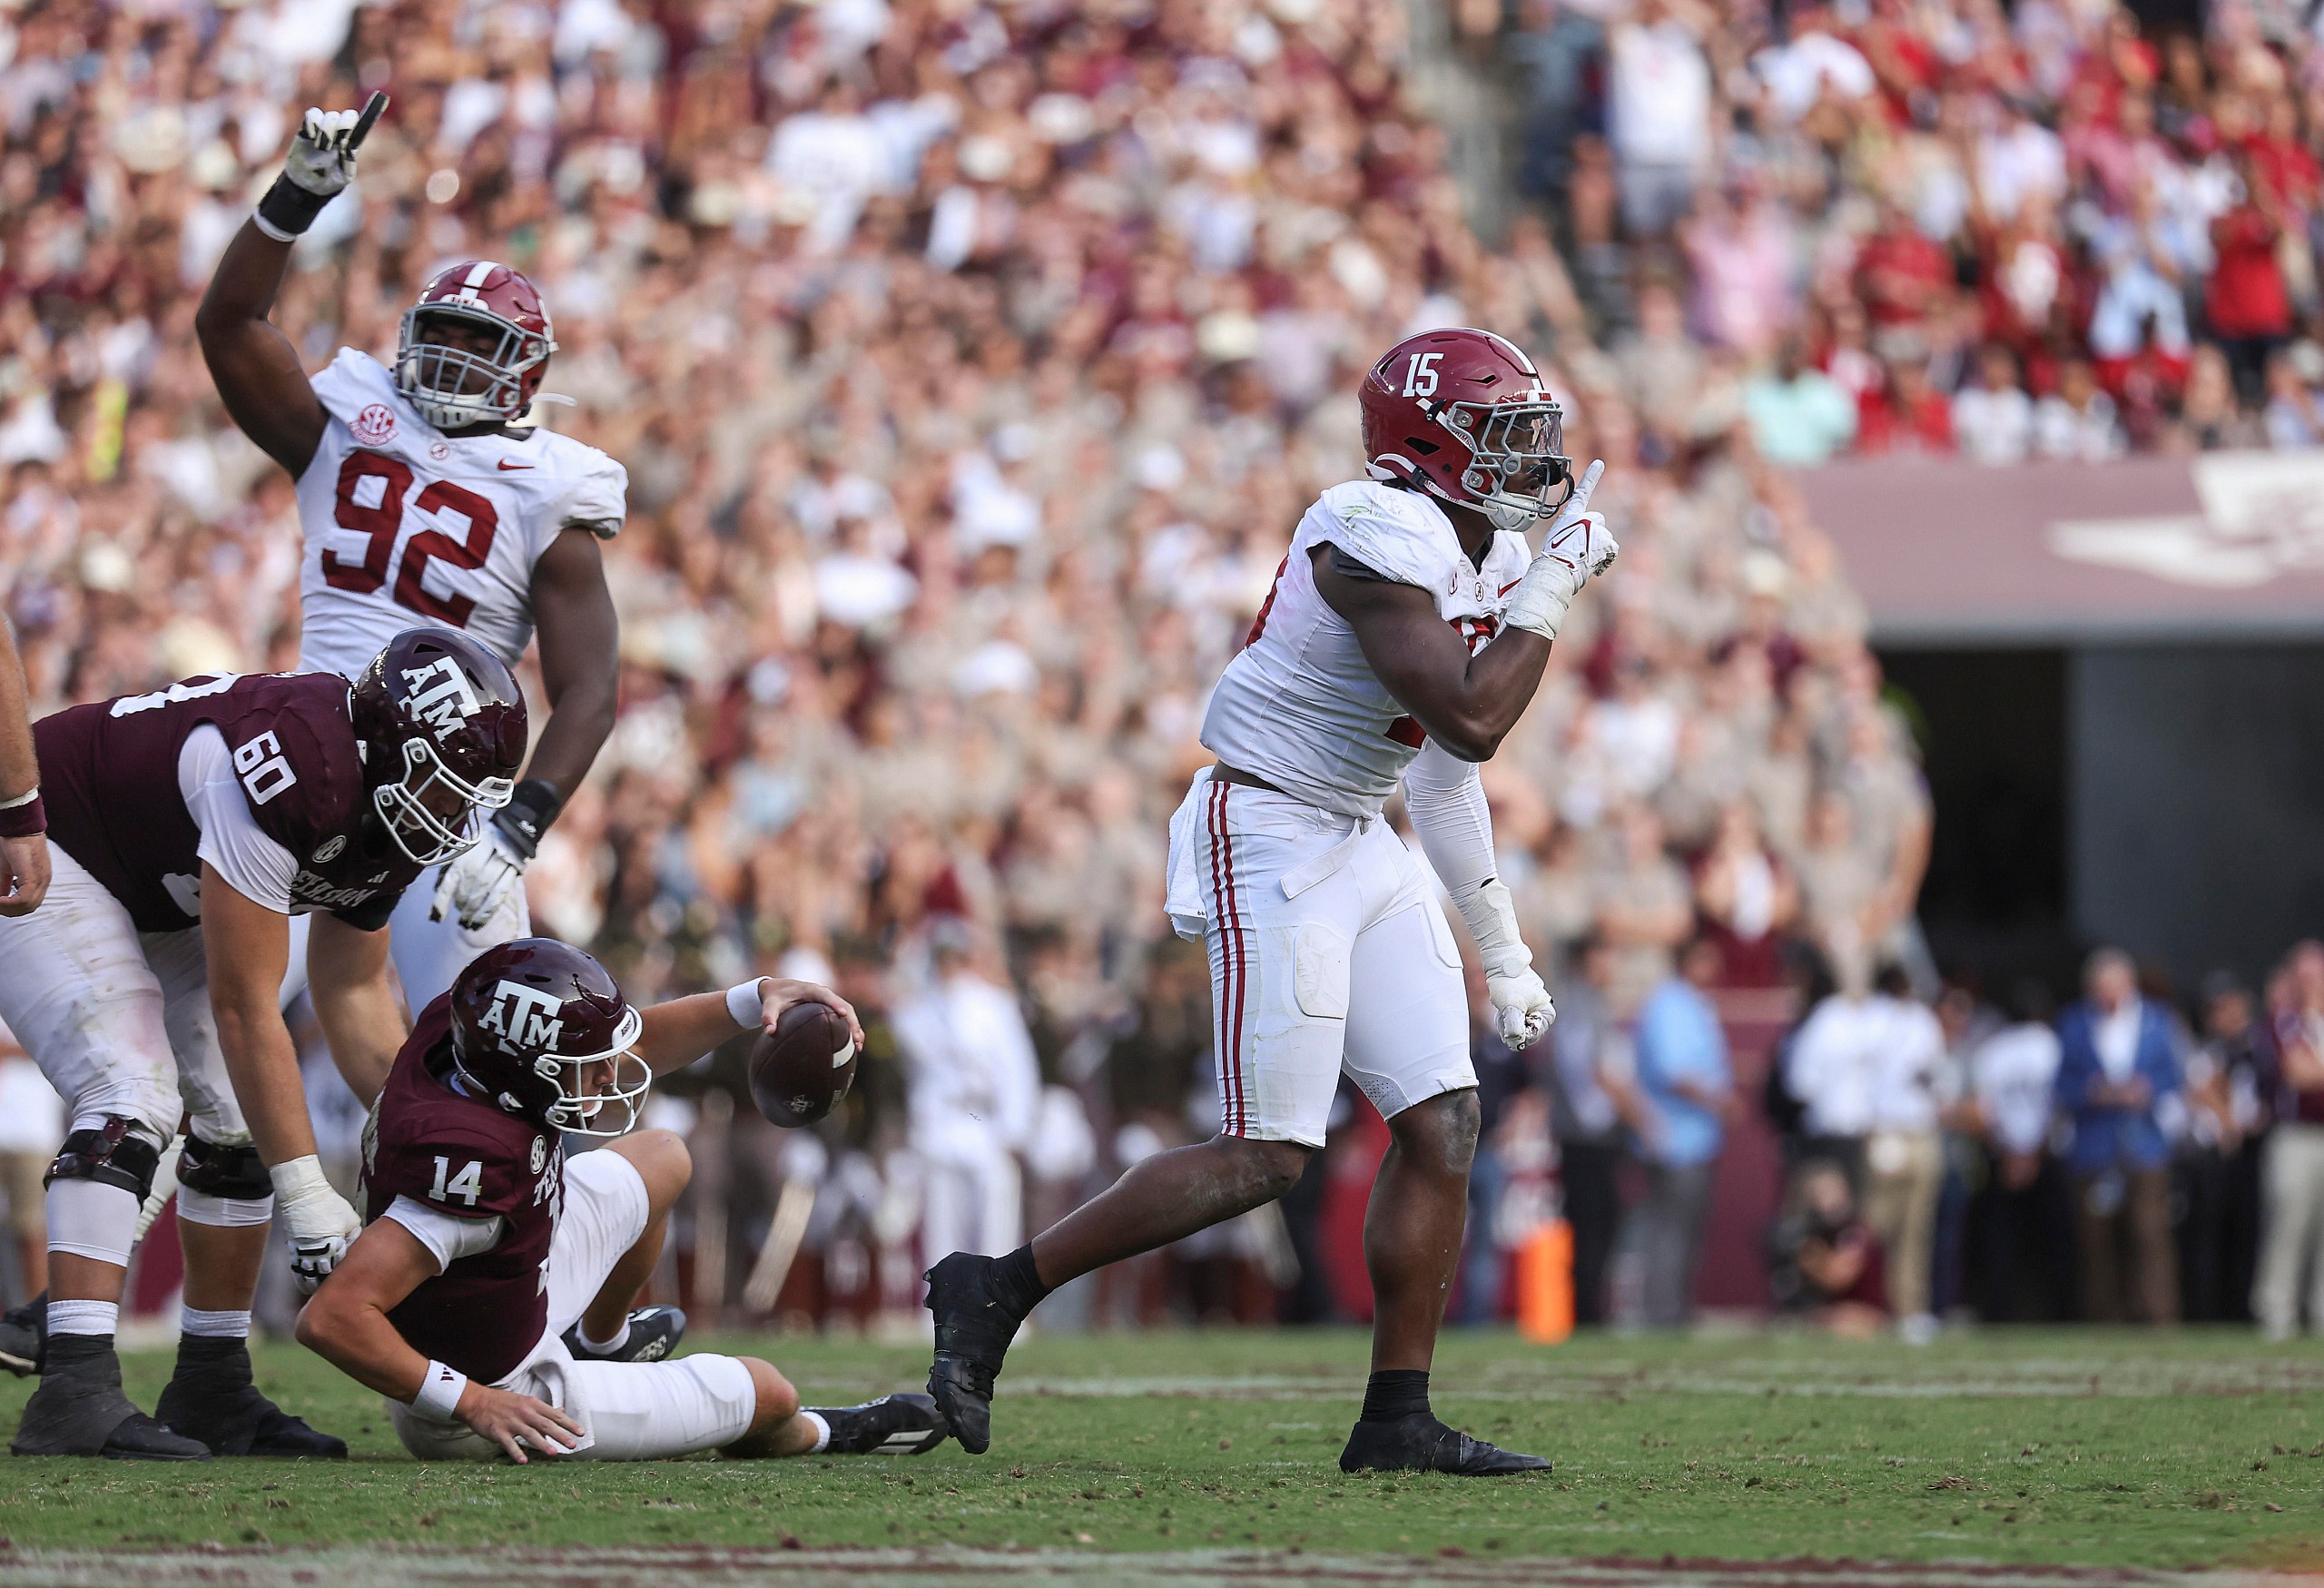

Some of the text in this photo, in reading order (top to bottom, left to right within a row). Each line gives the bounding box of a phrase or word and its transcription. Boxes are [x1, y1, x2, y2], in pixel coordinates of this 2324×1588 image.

[1403, 353, 1444, 398] 15
[1452, 429, 1474, 450] CRIMSO
[321, 449, 498, 628] 92
[233, 730, 297, 805] 60
[428, 1156, 483, 1206] 14
